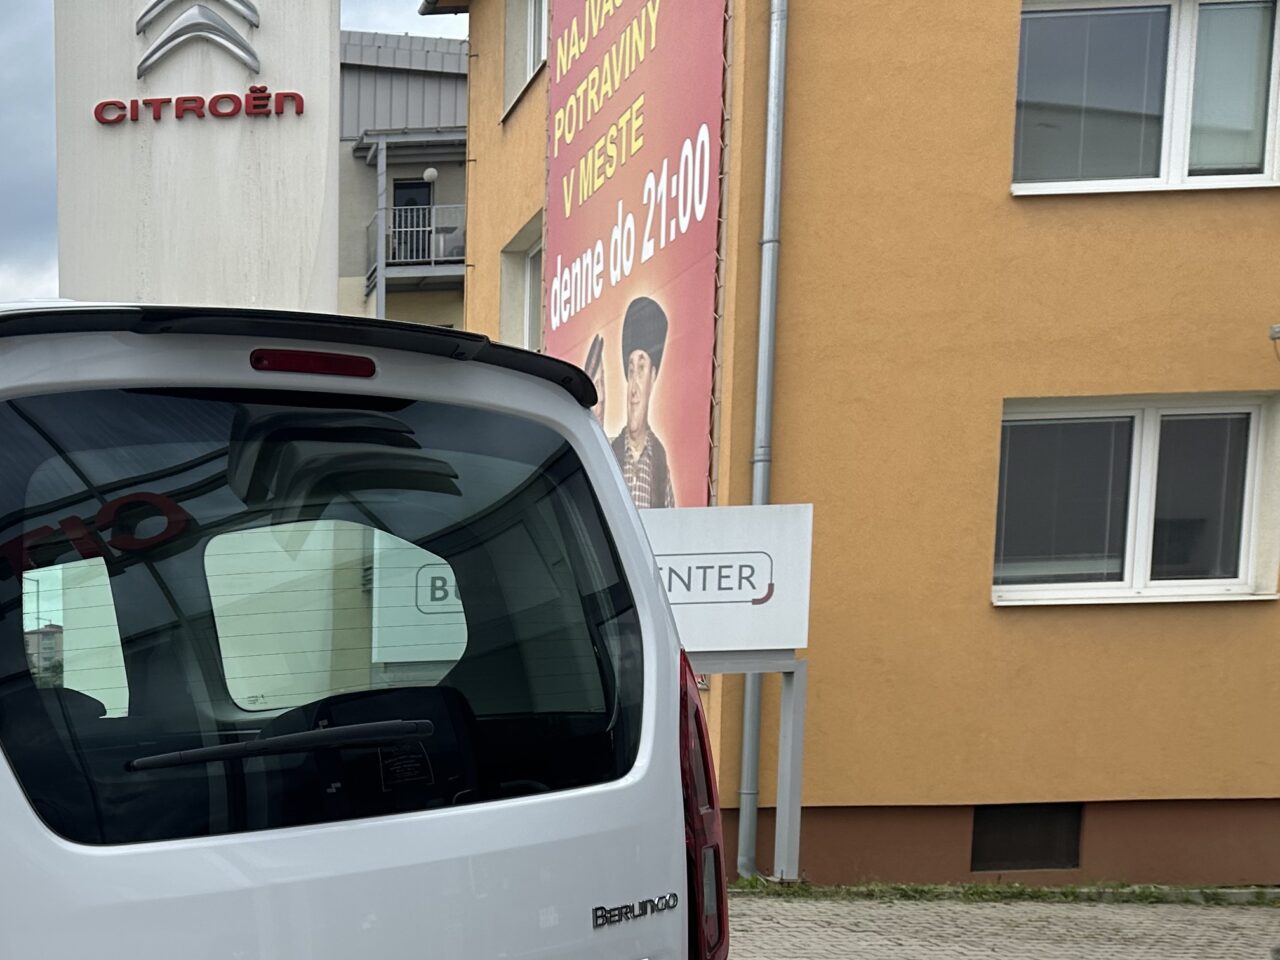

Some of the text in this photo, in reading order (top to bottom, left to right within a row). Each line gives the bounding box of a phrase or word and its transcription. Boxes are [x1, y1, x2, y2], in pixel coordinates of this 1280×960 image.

[554, 0, 661, 158] POTRAVINY
[550, 122, 710, 332] denne do 21:00
[562, 93, 646, 219] V MESTE
[659, 564, 757, 593] NTER
